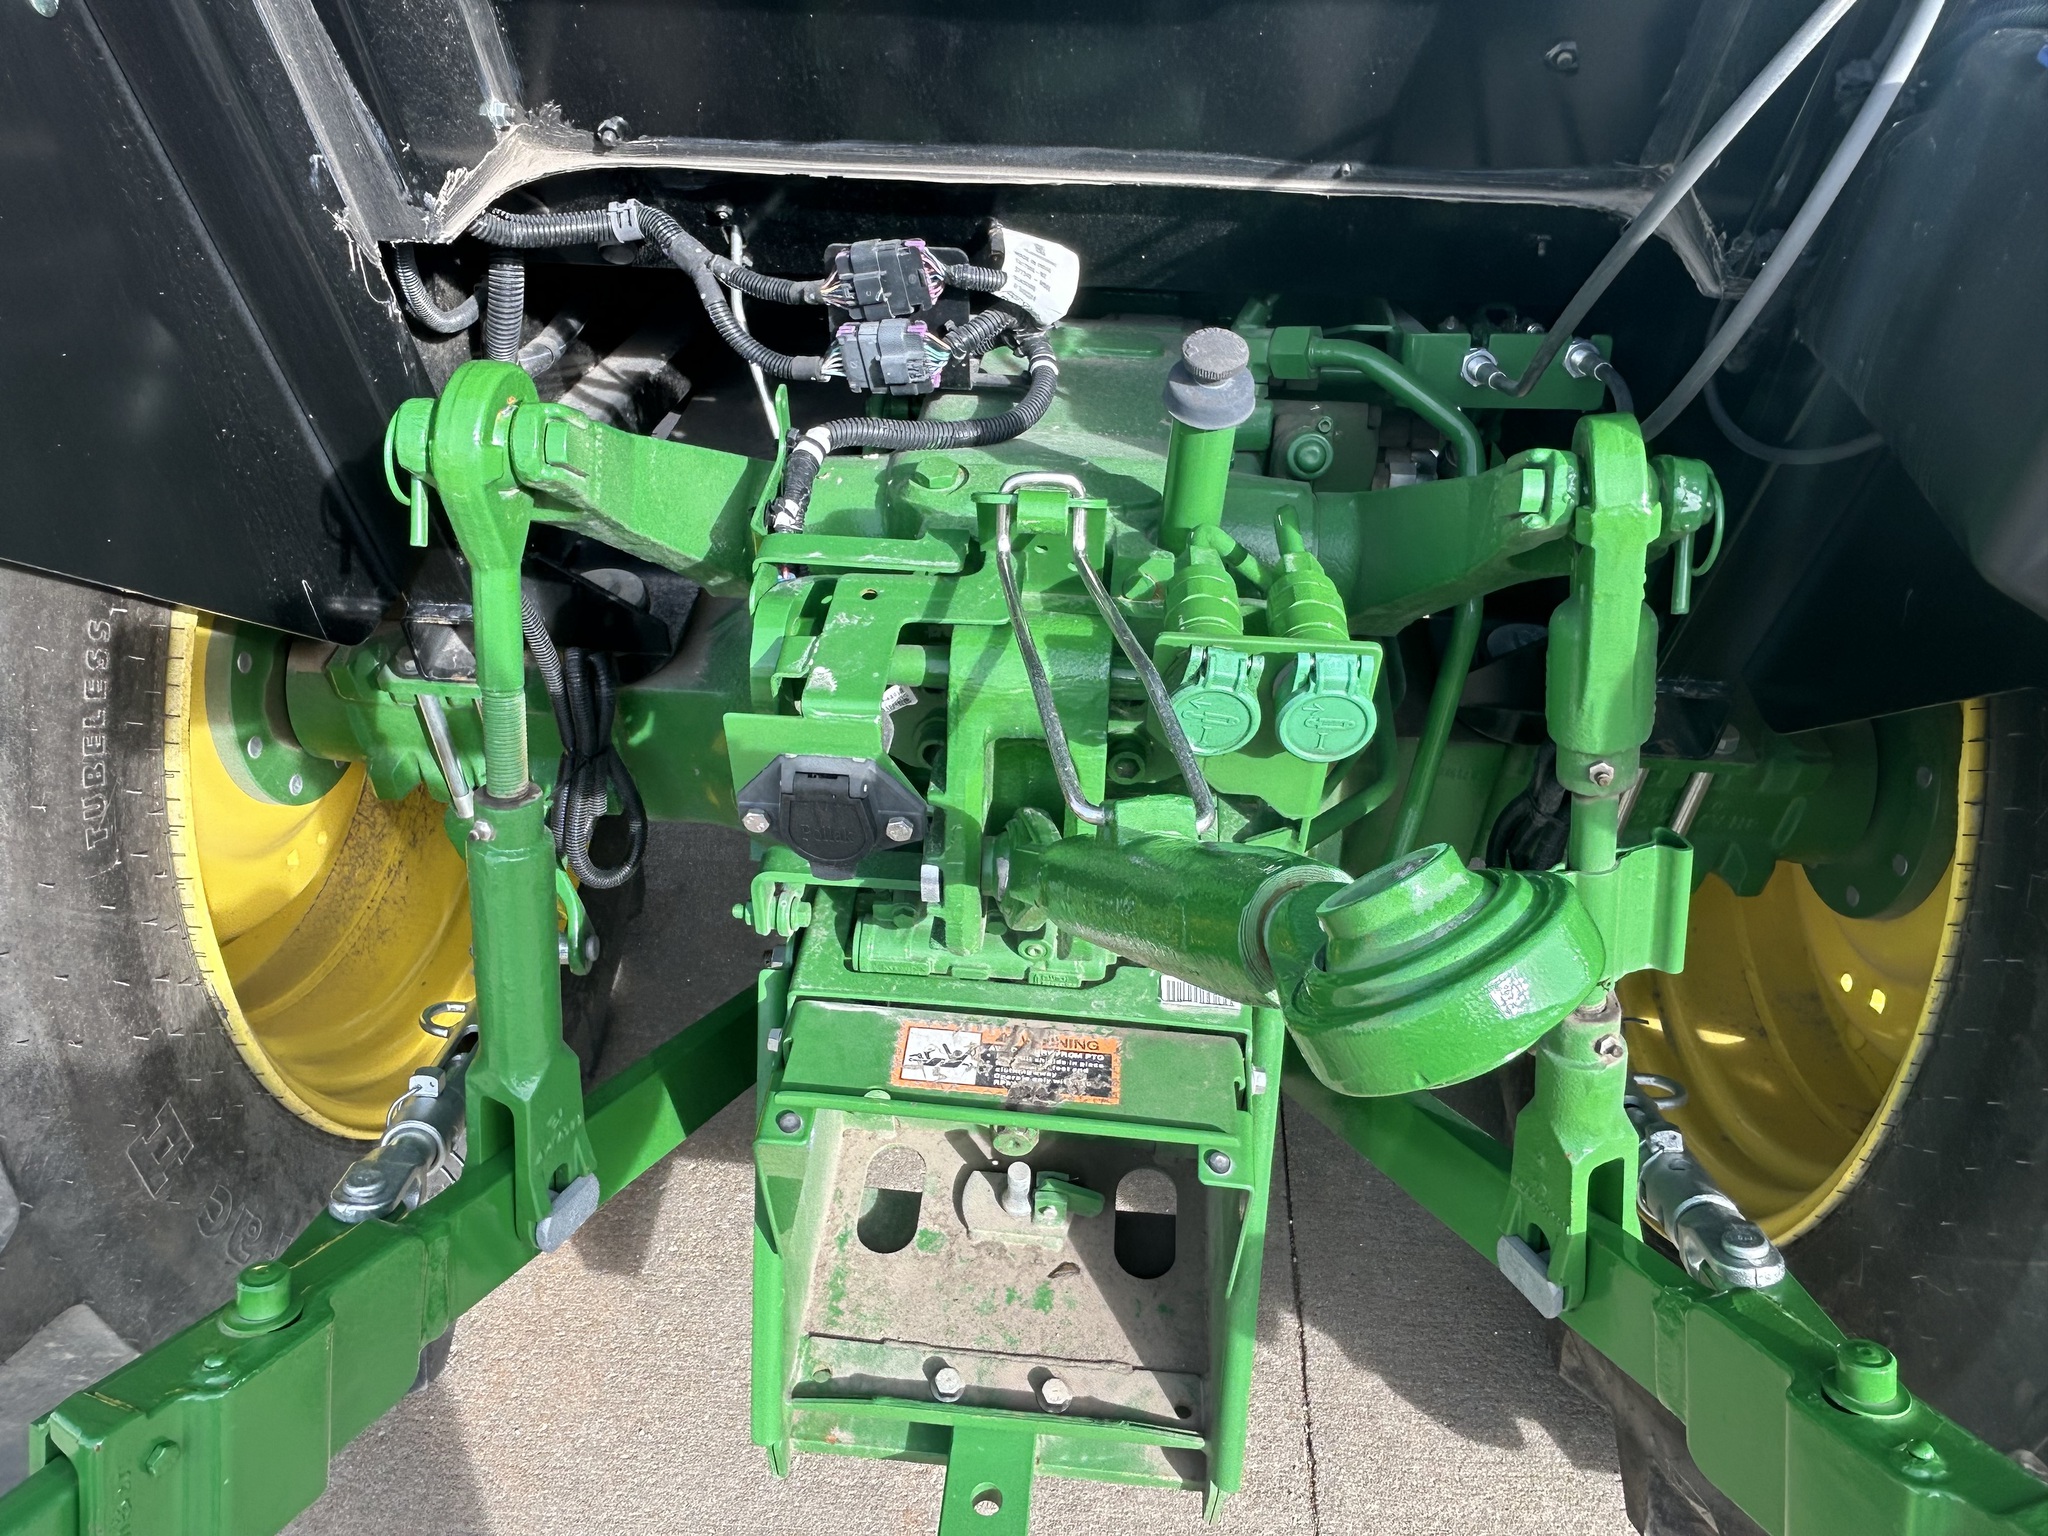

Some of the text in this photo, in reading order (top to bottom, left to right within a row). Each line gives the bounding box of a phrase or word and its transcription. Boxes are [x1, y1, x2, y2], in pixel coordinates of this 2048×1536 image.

[82, 619, 111, 851] TUBELESS
[801, 823, 855, 843] Pollak
[1084, 1053, 1105, 1061] PTO
